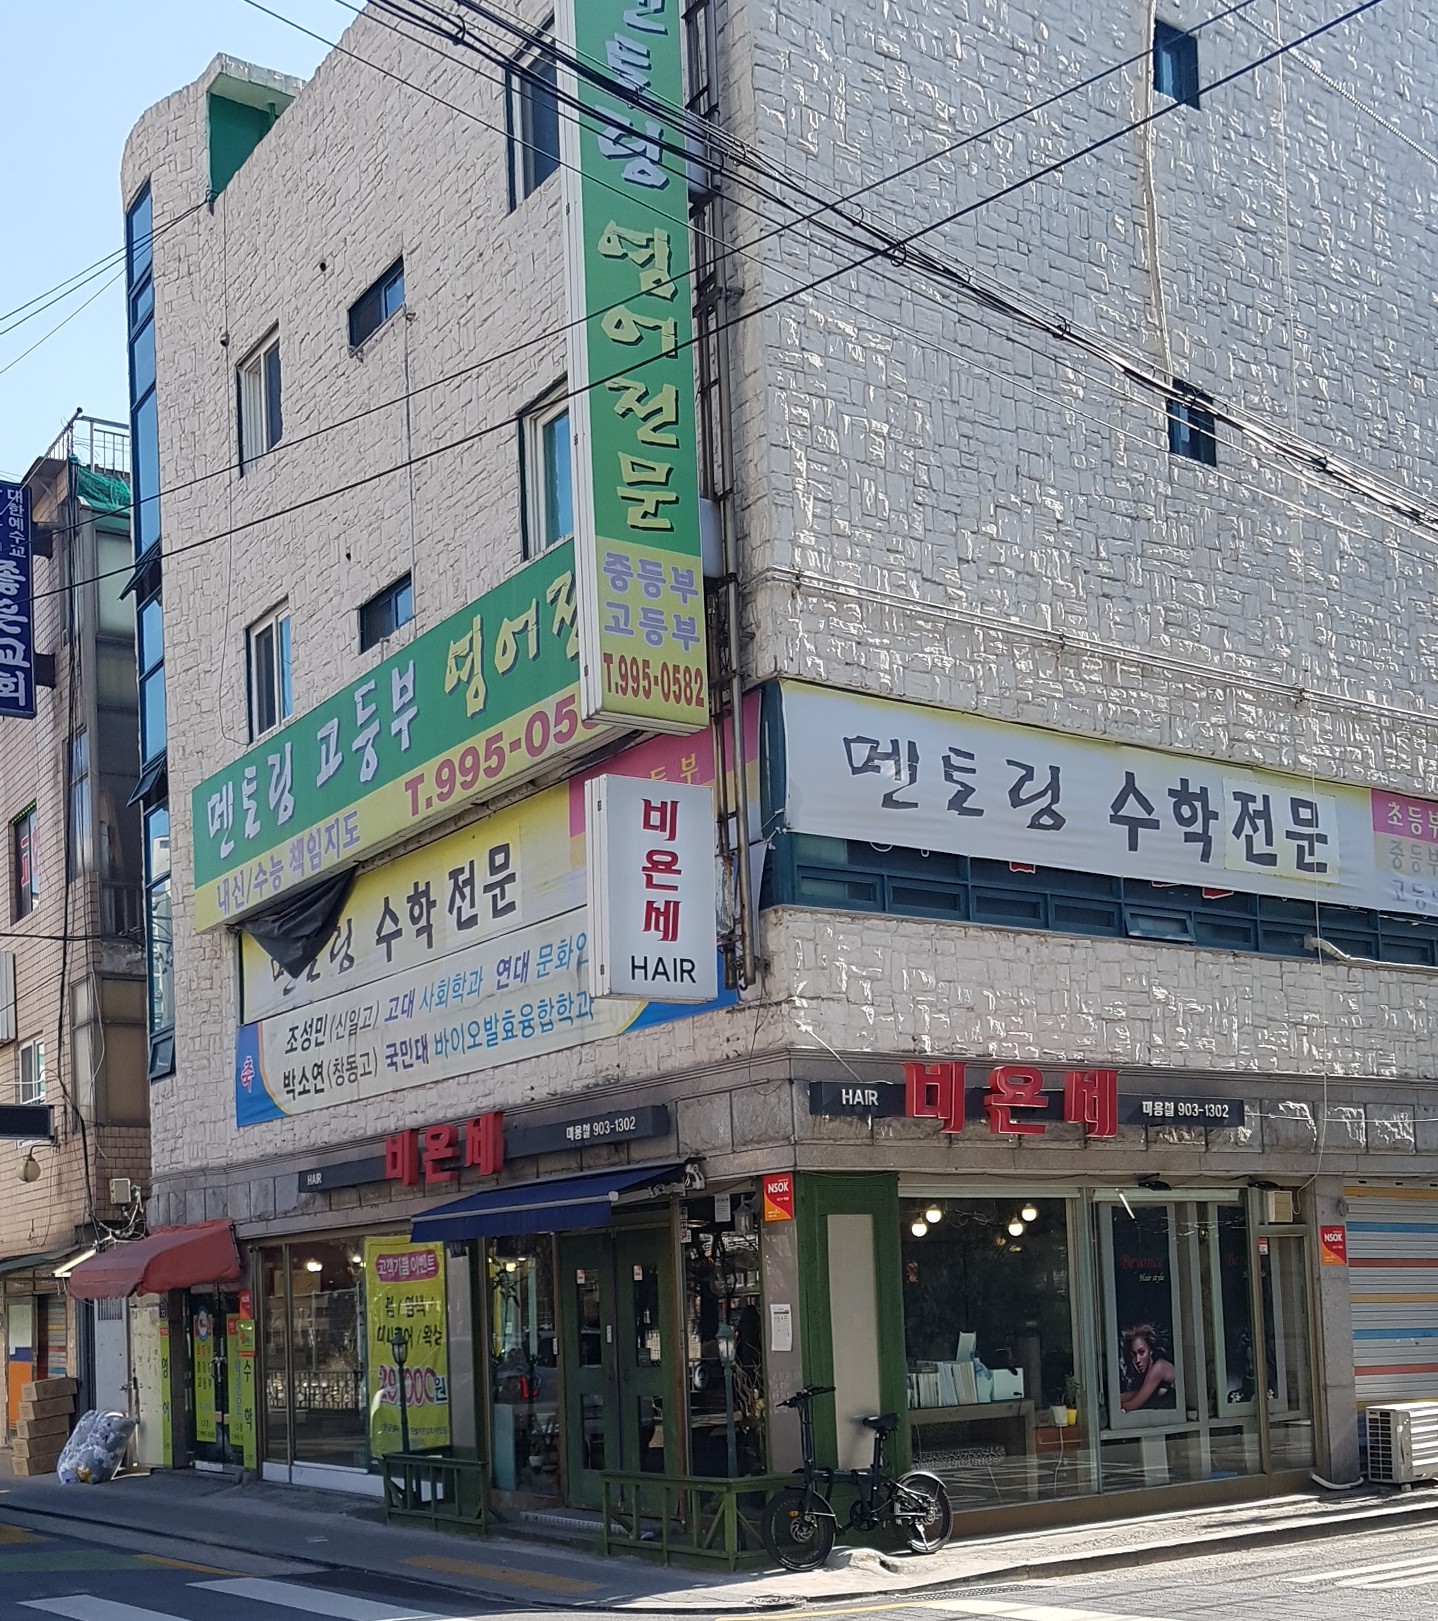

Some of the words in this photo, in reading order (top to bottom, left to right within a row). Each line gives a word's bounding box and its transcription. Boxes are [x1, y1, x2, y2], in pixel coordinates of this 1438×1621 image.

[598, 220, 678, 532] 영어전문
[7, 489, 26, 558] 대한예수교
[603, 552, 699, 604] 중등부
[604, 600, 700, 651] 고등부
[603, 652, 705, 708] T.995-0582
[317, 659, 417, 787] 고등부
[404, 694, 598, 816] T.995-05
[1388, 801, 1438, 840] 초등부
[216, 855, 284, 915] 내신/수능
[290, 811, 361, 877] 책임지도
[640, 798, 682, 942] 비욘세
[1389, 839, 1438, 877] 중등부
[630, 955, 697, 984] HAIR
[284, 1000, 379, 1055] 조성민(신일고)
[384, 988, 416, 1023] 고대
[419, 966, 483, 1014] 사회학과
[495, 950, 530, 991] 연대
[283, 1046, 378, 1101] 박소연(창동고)
[385, 1032, 430, 1073] 국민대
[434, 990, 595, 1060] 바이오발효융합학과
[841, 1088, 879, 1107] HAIR
[903, 1061, 1121, 1138] 비욘세
[1142, 1101, 1175, 1117] 미용실
[1177, 1102, 1229, 1118] 903-1302
[385, 1111, 504, 1187] 비욘세
[566, 1123, 591, 1141] 미용실
[592, 1116, 637, 1136] 903-1302
[307, 1173, 322, 1186] HAIR
[767, 1181, 789, 1195] NSOK
[1324, 1233, 1343, 1243] NSOK
